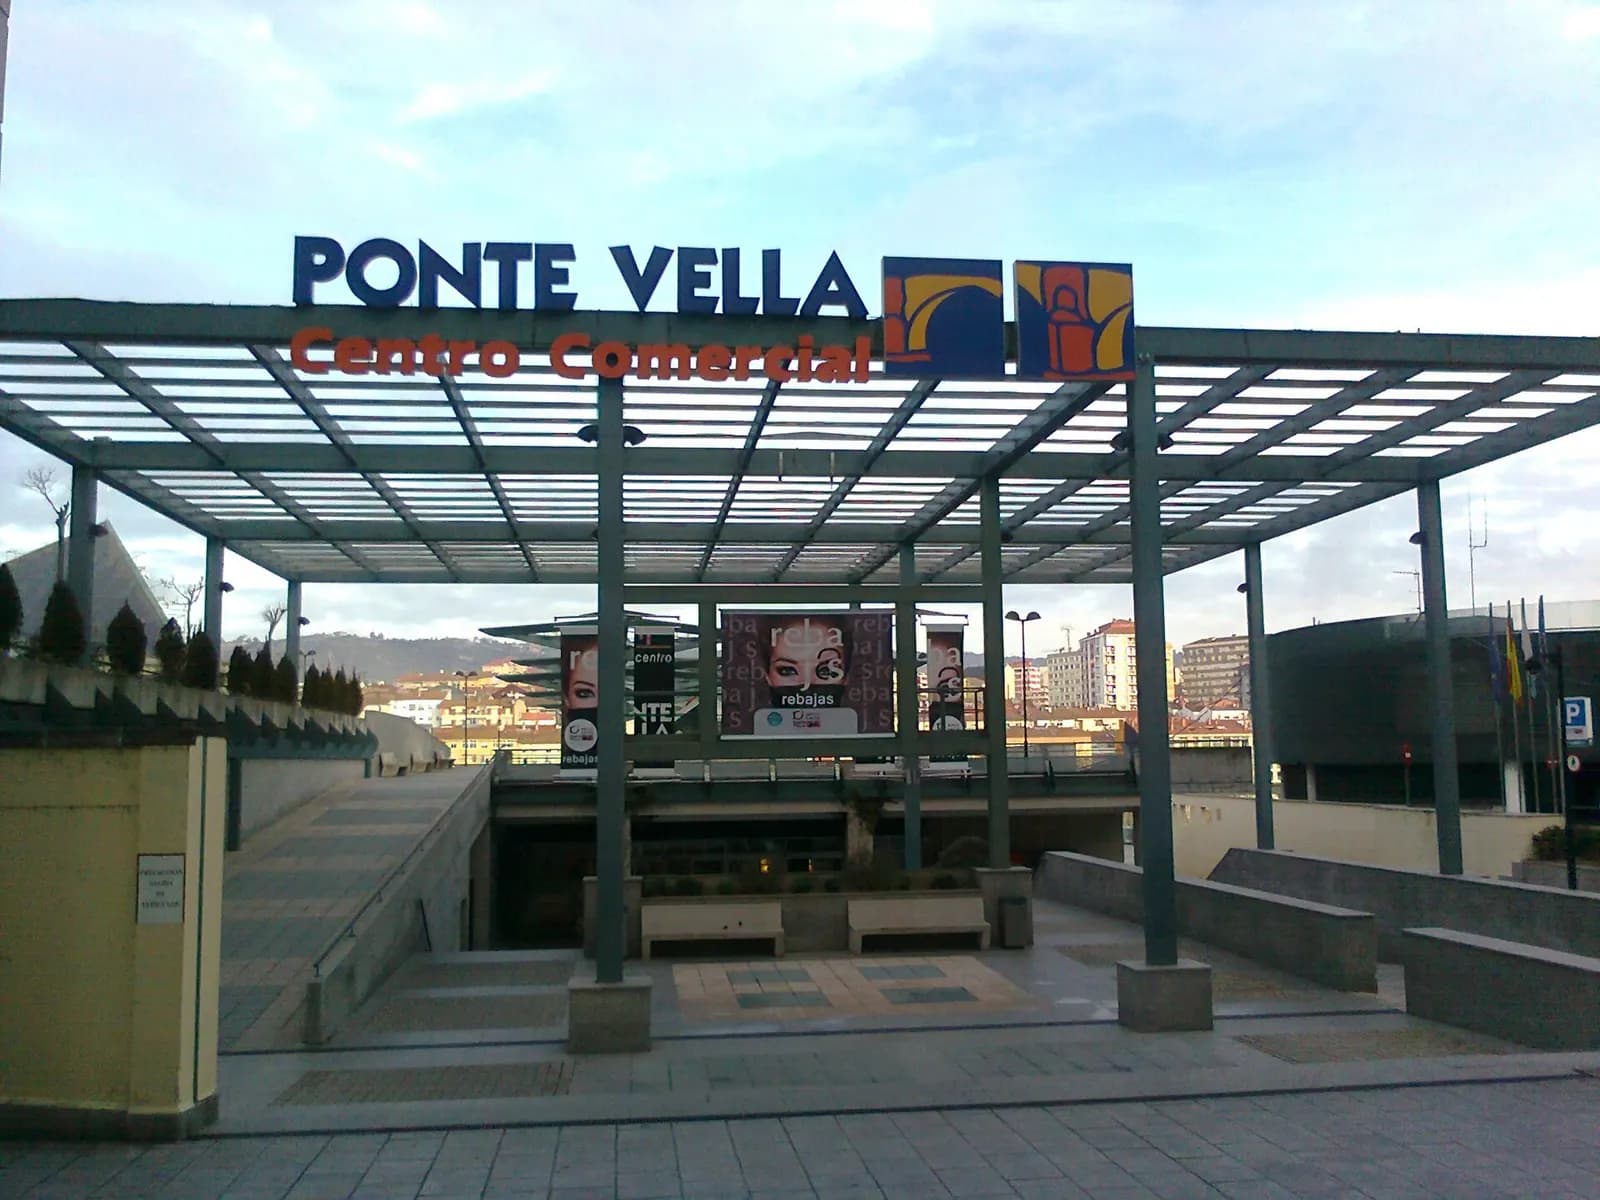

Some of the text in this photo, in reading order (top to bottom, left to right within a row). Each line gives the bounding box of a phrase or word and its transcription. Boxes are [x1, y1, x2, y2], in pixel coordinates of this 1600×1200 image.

[293, 236, 868, 318] PONTE VELLA
[290, 327, 872, 384] Centro Comercial
[635, 652, 673, 663] centro
[781, 693, 834, 708] rebajas
[1566, 704, 1580, 724] P
